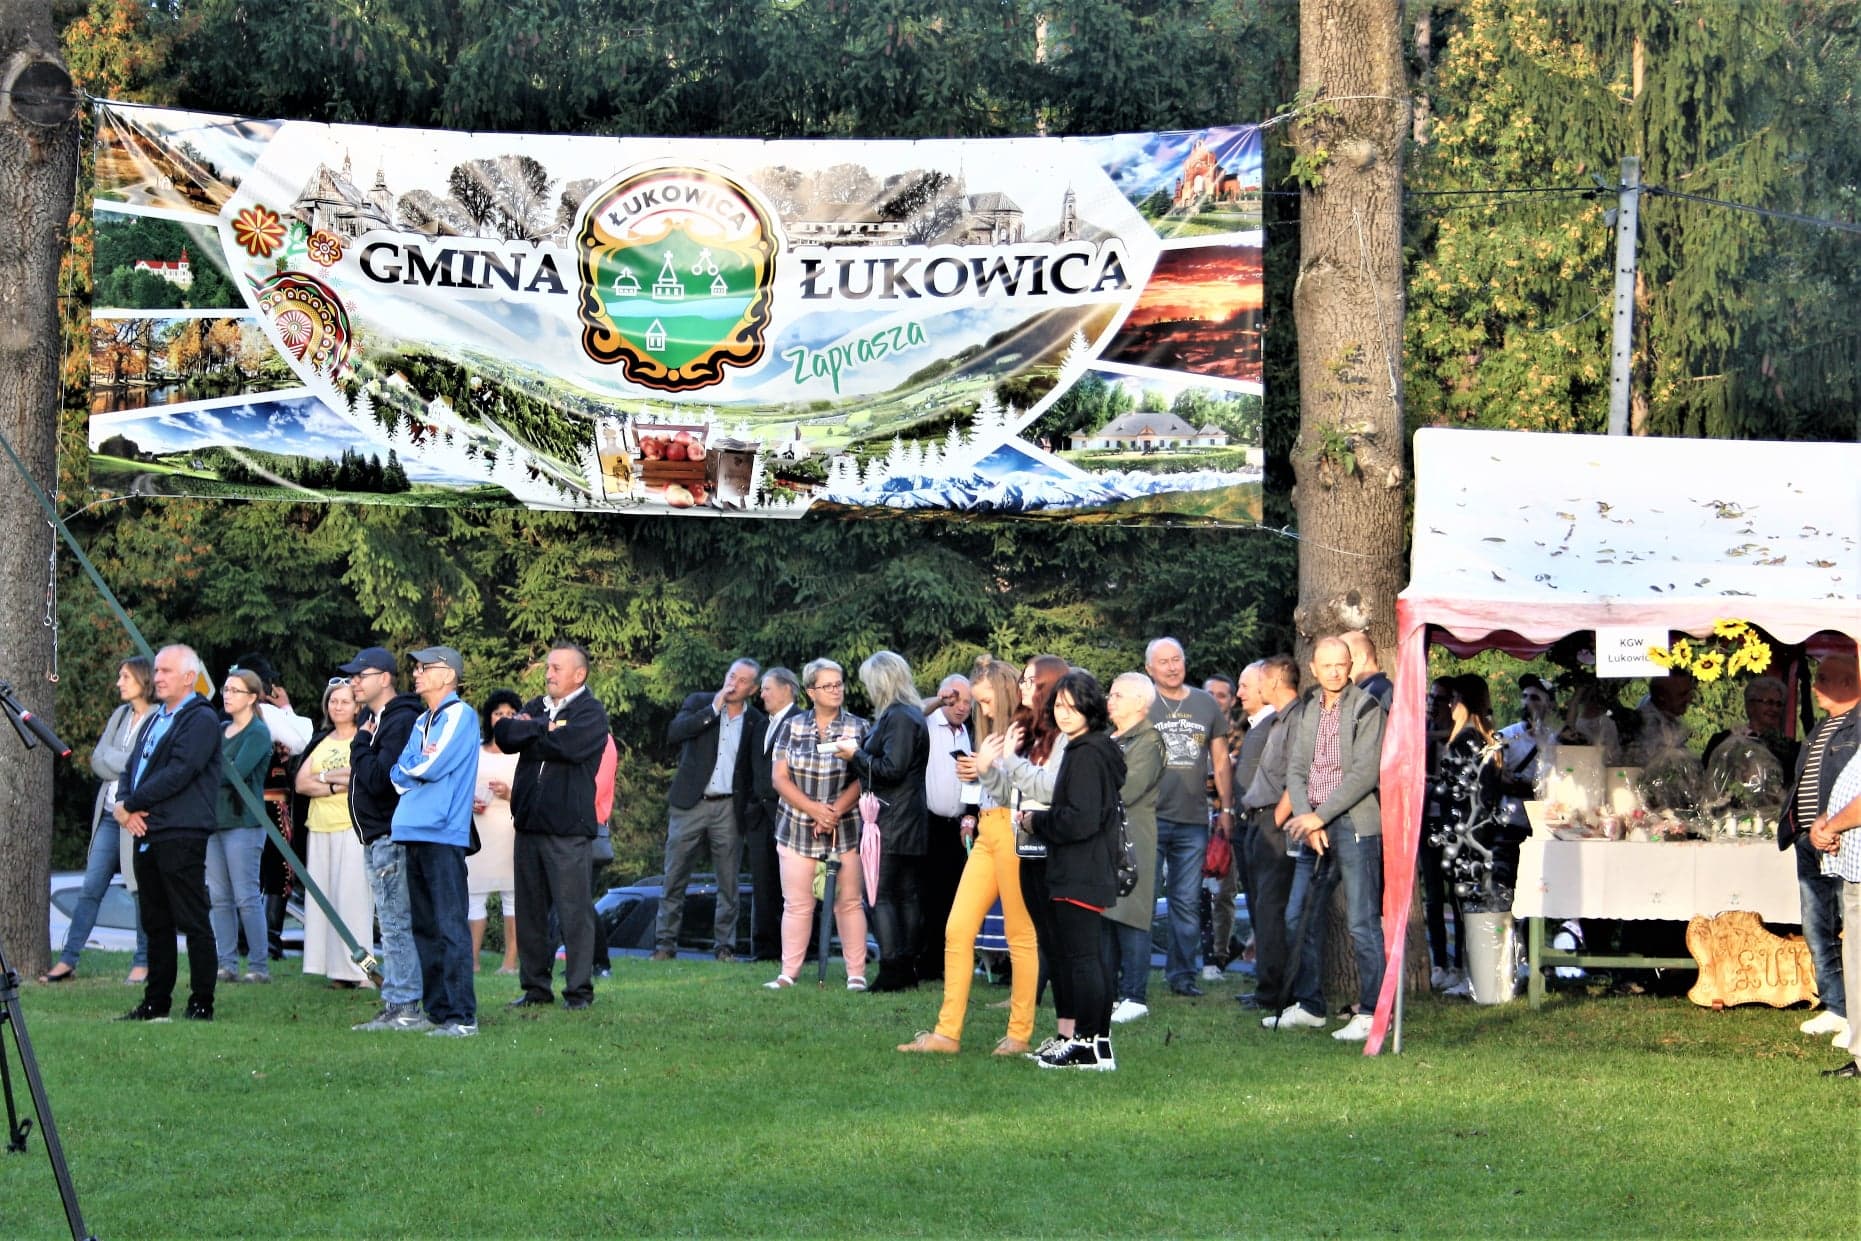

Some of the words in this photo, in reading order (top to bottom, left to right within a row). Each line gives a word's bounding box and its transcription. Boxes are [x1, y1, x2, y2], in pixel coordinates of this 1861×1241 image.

[608, 185, 747, 232] ŁUKOWICA
[359, 242, 569, 295] GMINA
[800, 250, 1132, 300] ŁUKOWICA
[786, 321, 927, 395] Zaprasza
[1619, 638, 1644, 648] KGW
[1731, 948, 1815, 990] ŁUK
